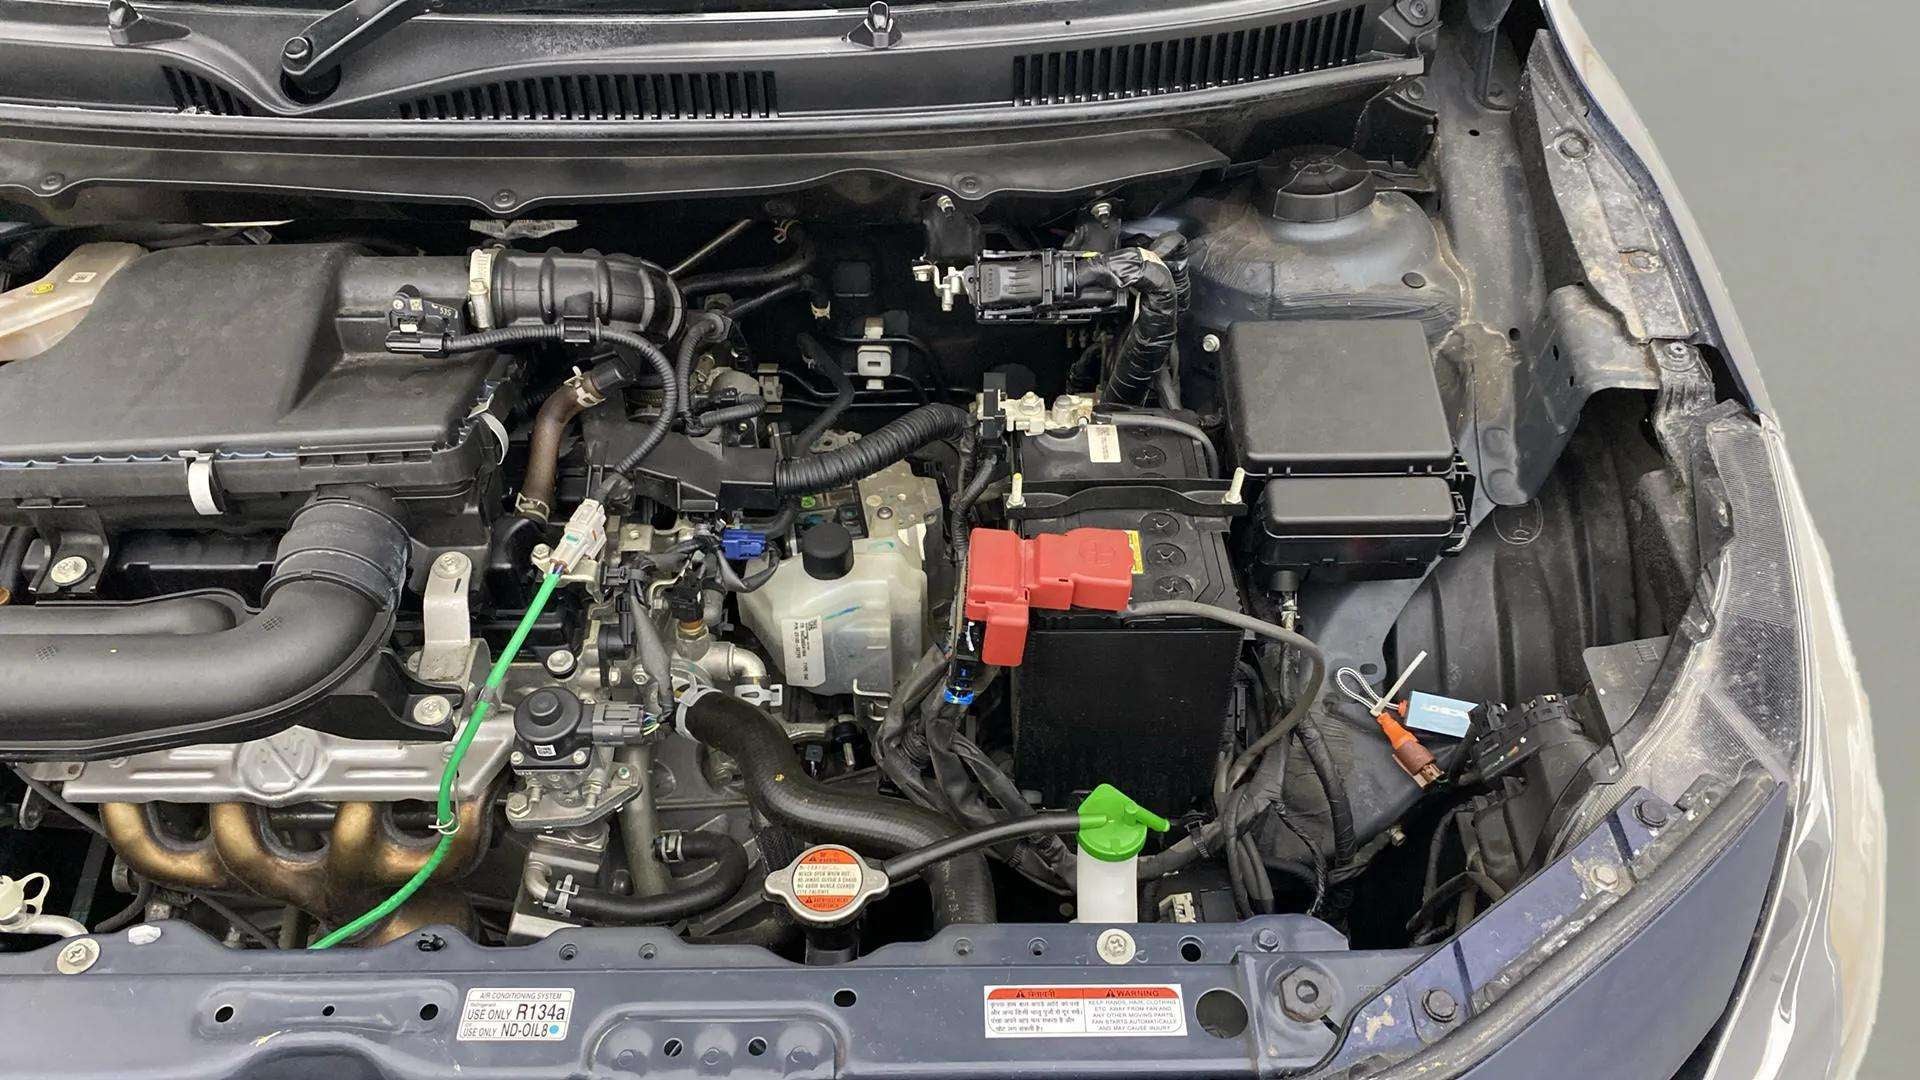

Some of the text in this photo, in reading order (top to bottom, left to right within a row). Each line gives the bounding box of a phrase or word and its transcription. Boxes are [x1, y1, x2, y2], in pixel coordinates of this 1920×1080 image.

[468, 1004, 565, 1020] USE ONLY R134a
[464, 1023, 549, 1037] USE ONLY ND-OIL8
